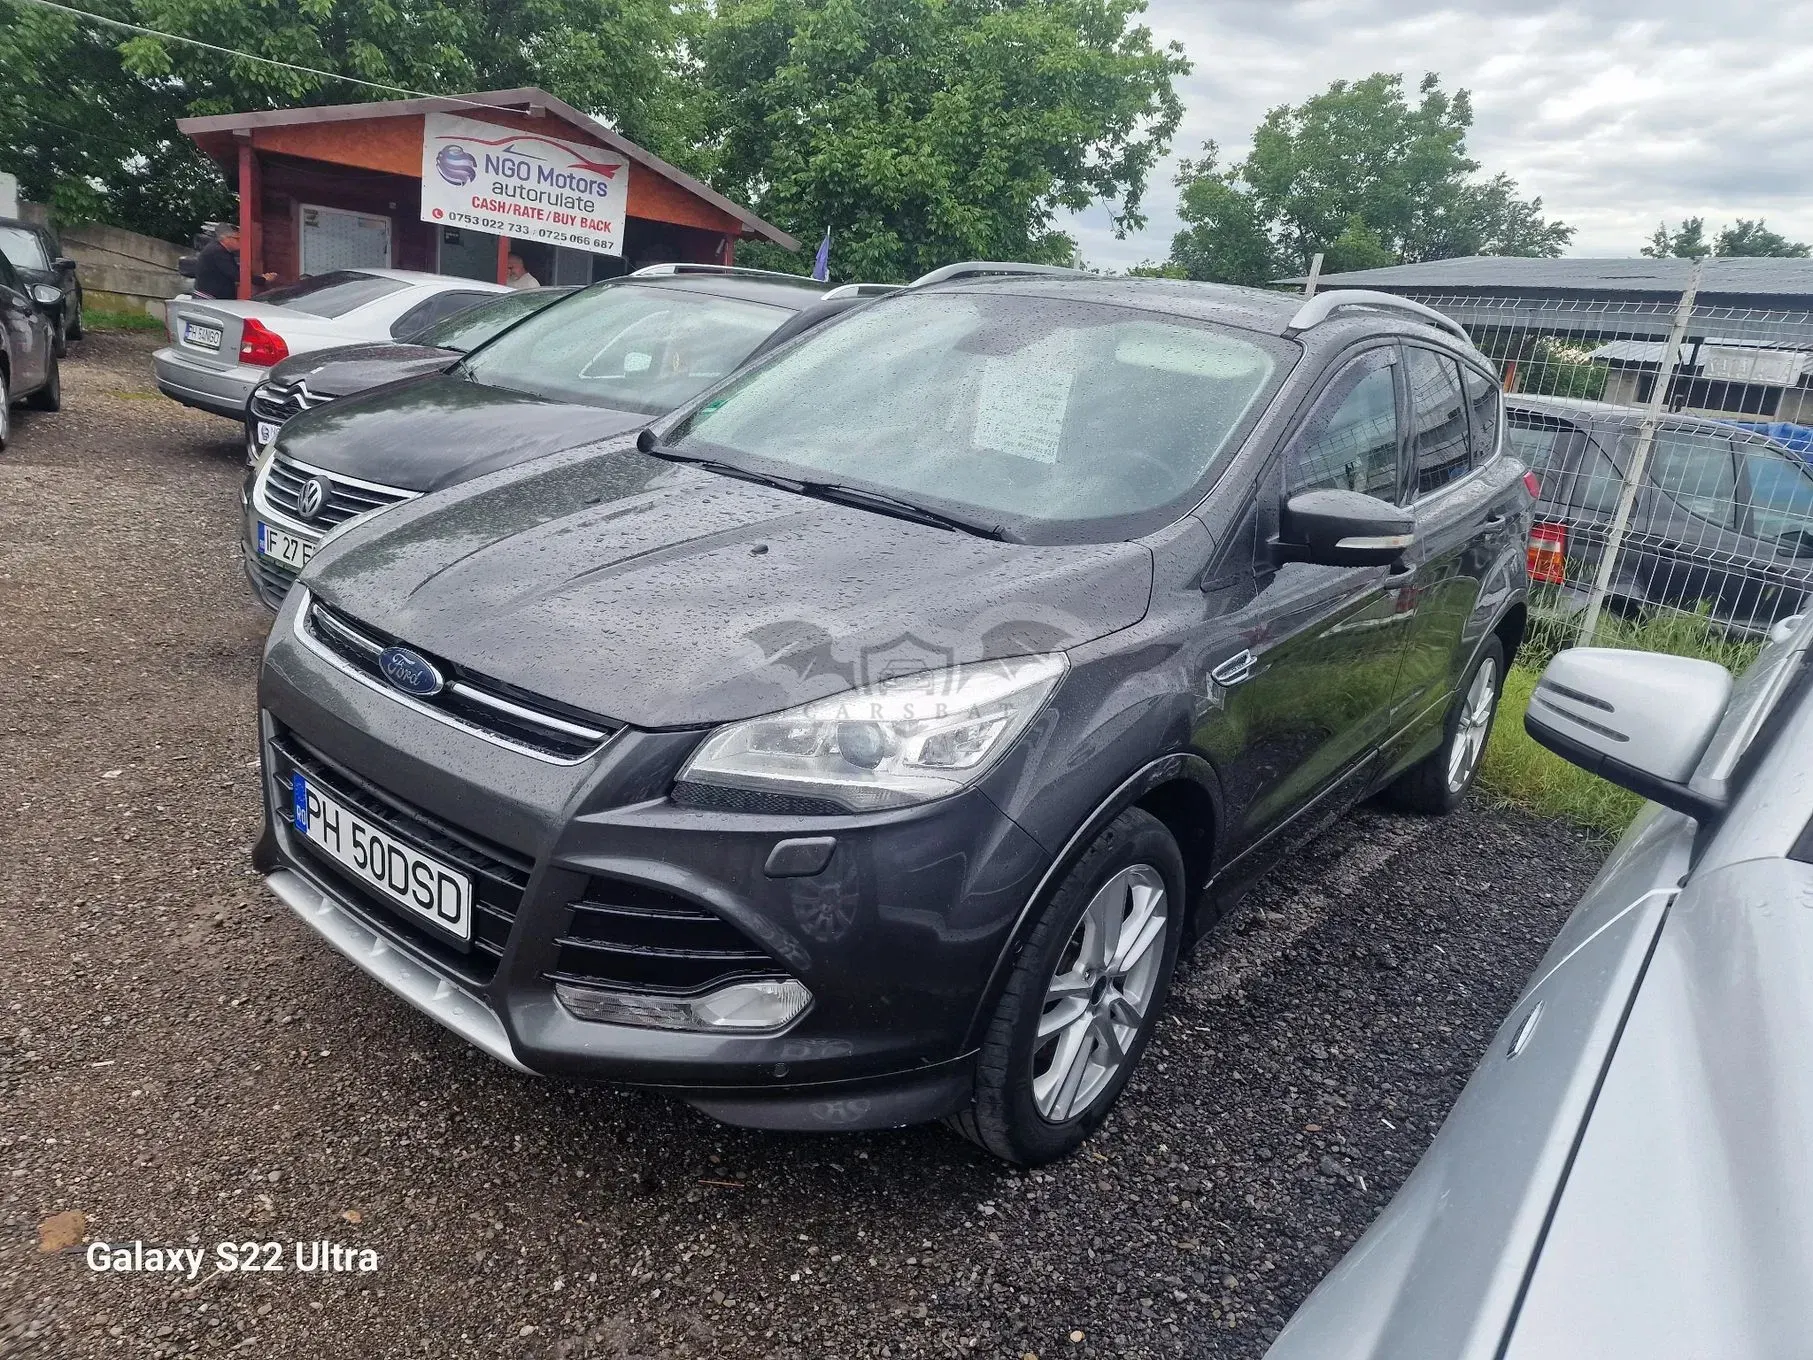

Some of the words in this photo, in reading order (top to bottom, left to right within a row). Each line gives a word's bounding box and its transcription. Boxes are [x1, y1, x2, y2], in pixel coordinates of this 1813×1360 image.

[484, 153, 531, 181] NGO
[537, 165, 608, 197] Motors
[491, 180, 595, 213] autorulate
[448, 211, 480, 225] 0753
[482, 218, 504, 230] 022
[508, 222, 530, 235] 733
[538, 228, 567, 241] 0725
[569, 234, 591, 246] 066
[593, 238, 614, 250] 687
[580, 216, 612, 233] BACK
[282, 536, 299, 561] 27
[387, 653, 424, 686] Ford
[305, 788, 341, 853] PH
[352, 821, 462, 925] 50DSD
